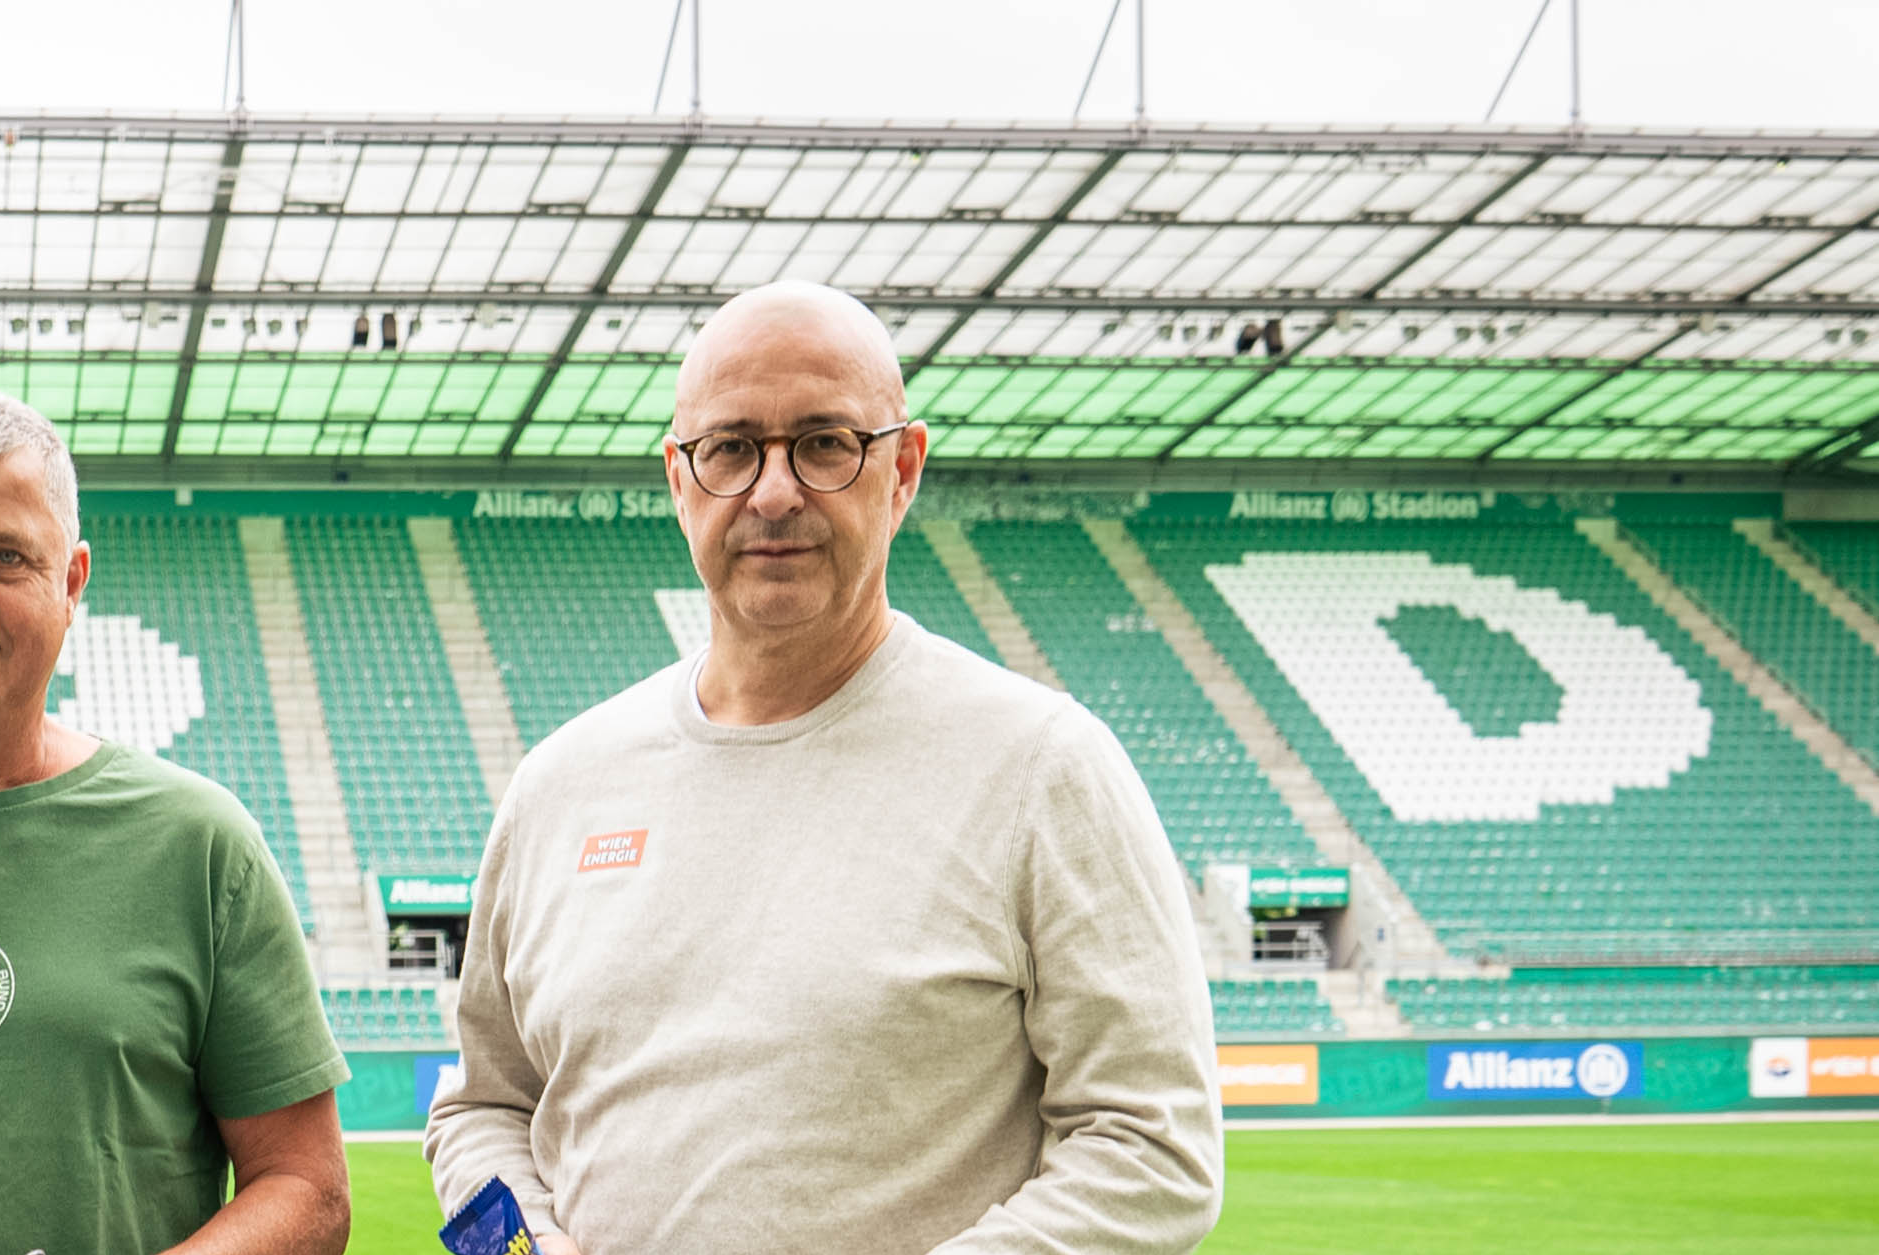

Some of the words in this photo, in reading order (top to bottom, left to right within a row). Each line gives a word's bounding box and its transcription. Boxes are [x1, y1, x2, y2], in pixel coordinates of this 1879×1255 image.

[473, 490, 575, 518] Allianz
[1229, 491, 1327, 519] Allianz
[1372, 490, 1479, 519] Stadion
[584, 848, 638, 867] ENERGIE
[598, 837, 633, 850] WIEN
[1443, 1050, 1575, 1089] Allianz
